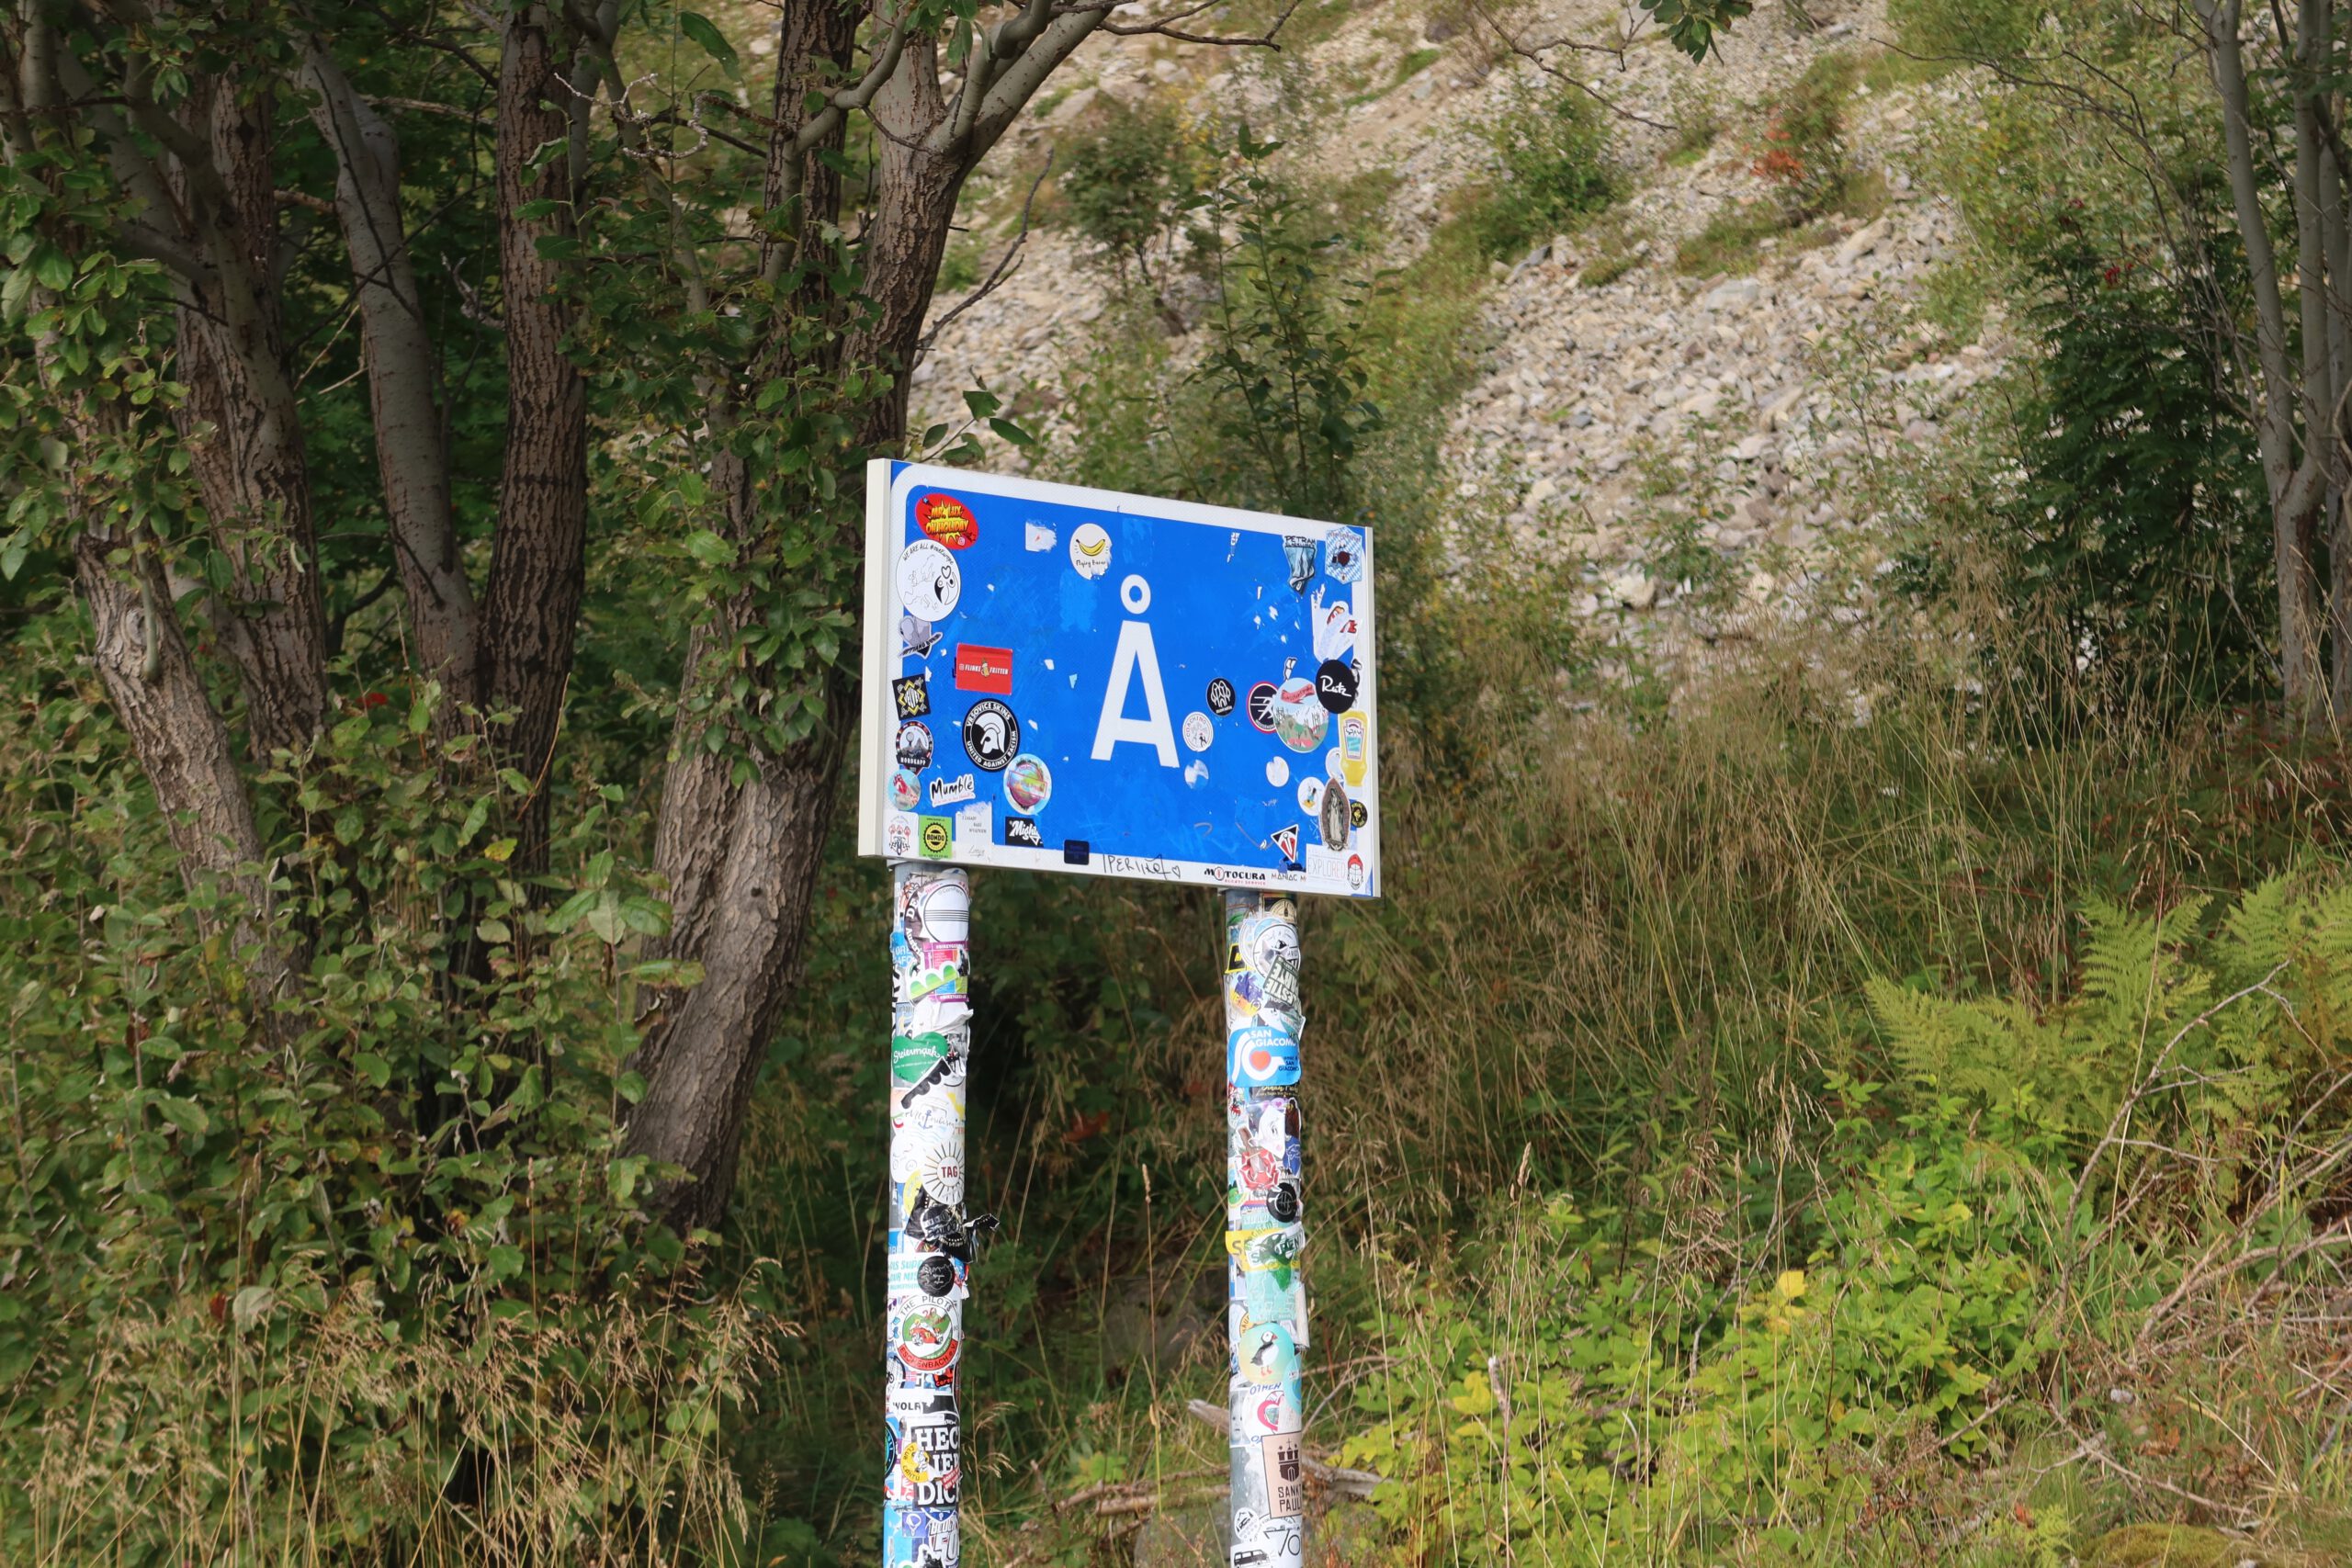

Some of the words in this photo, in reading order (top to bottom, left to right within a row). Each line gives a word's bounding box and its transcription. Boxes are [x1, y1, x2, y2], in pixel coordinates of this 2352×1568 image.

[939, 519, 969, 533] HOLIDAY
[1091, 574, 1180, 768] Å
[992, 703, 1012, 720] SKINS
[967, 740, 982, 763] UNITED
[983, 756, 1009, 768] AGAINST
[932, 775, 973, 799] Mumble
[1250, 1029, 1272, 1038] SAN
[941, 1166, 958, 1178] TAG
[900, 1300, 916, 1316] THE
[922, 1295, 956, 1313] PILOTS
[900, 1346, 949, 1369] ESCHENBACH
[1277, 1483, 1302, 1498] SANKT
